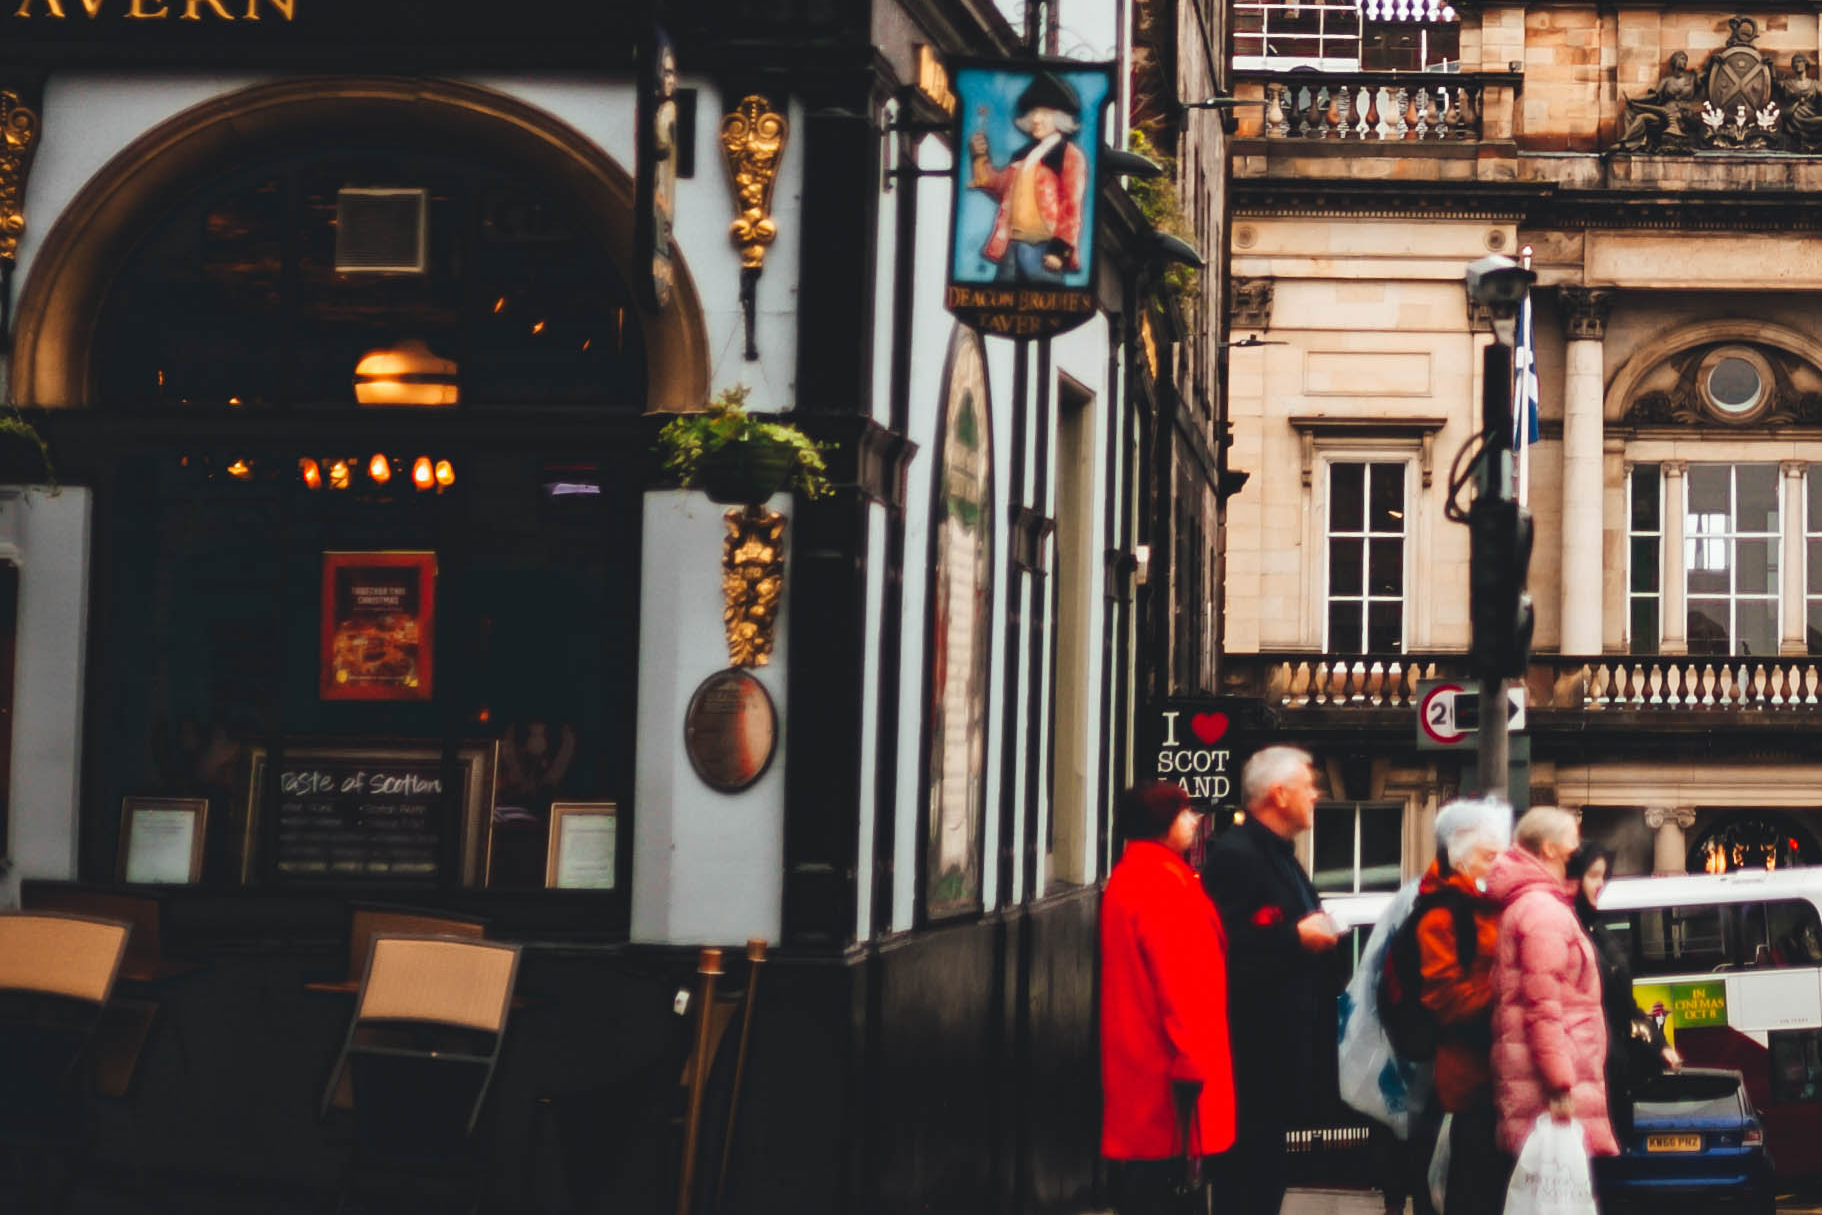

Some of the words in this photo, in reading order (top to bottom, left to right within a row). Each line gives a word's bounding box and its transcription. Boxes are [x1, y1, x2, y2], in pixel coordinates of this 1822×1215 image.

[1162, 711, 1181, 747] I
[1157, 750, 1231, 773] SCOT
[340, 771, 367, 795] of
[369, 772, 442, 796] Scotlan
[1157, 776, 1231, 798] AND
[1674, 998, 1724, 1011] CINEMAS
[1692, 989, 1706, 999] IN
[1684, 1009, 1707, 1020] OCT
